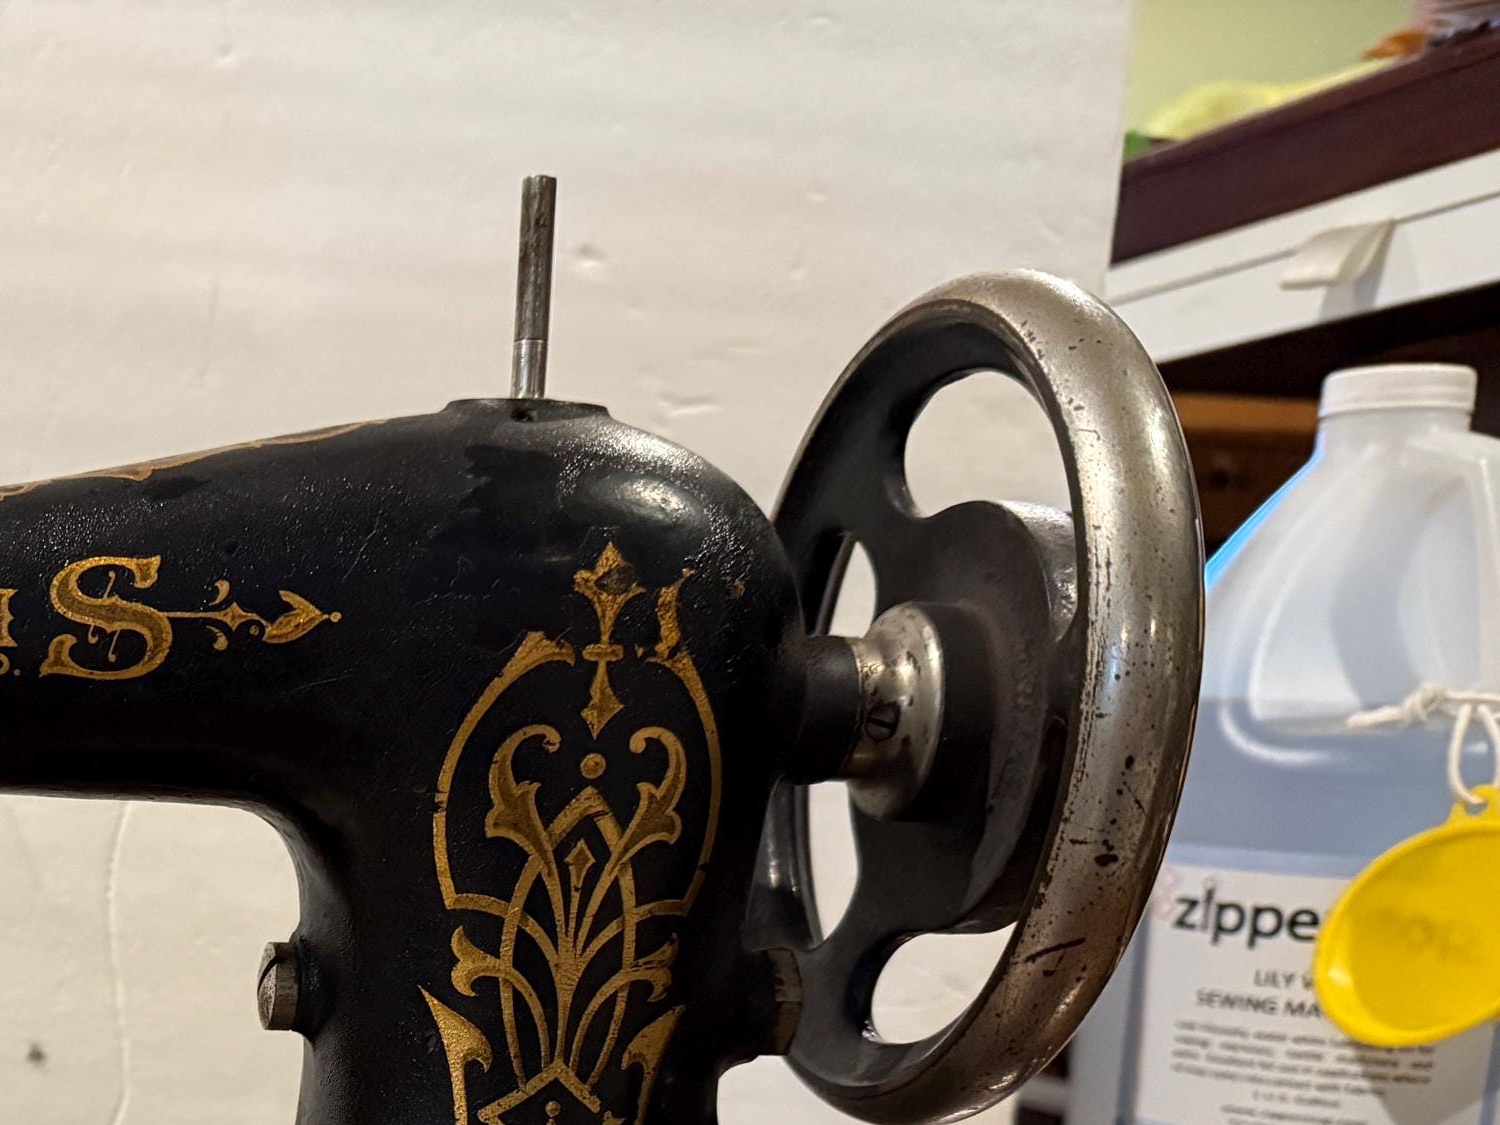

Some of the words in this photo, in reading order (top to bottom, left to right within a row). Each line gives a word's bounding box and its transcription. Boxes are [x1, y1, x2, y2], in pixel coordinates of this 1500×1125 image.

[1173, 882, 1320, 949] zippe
[1196, 988, 1277, 1016] SEWING
[1283, 999, 1324, 1020] MA
